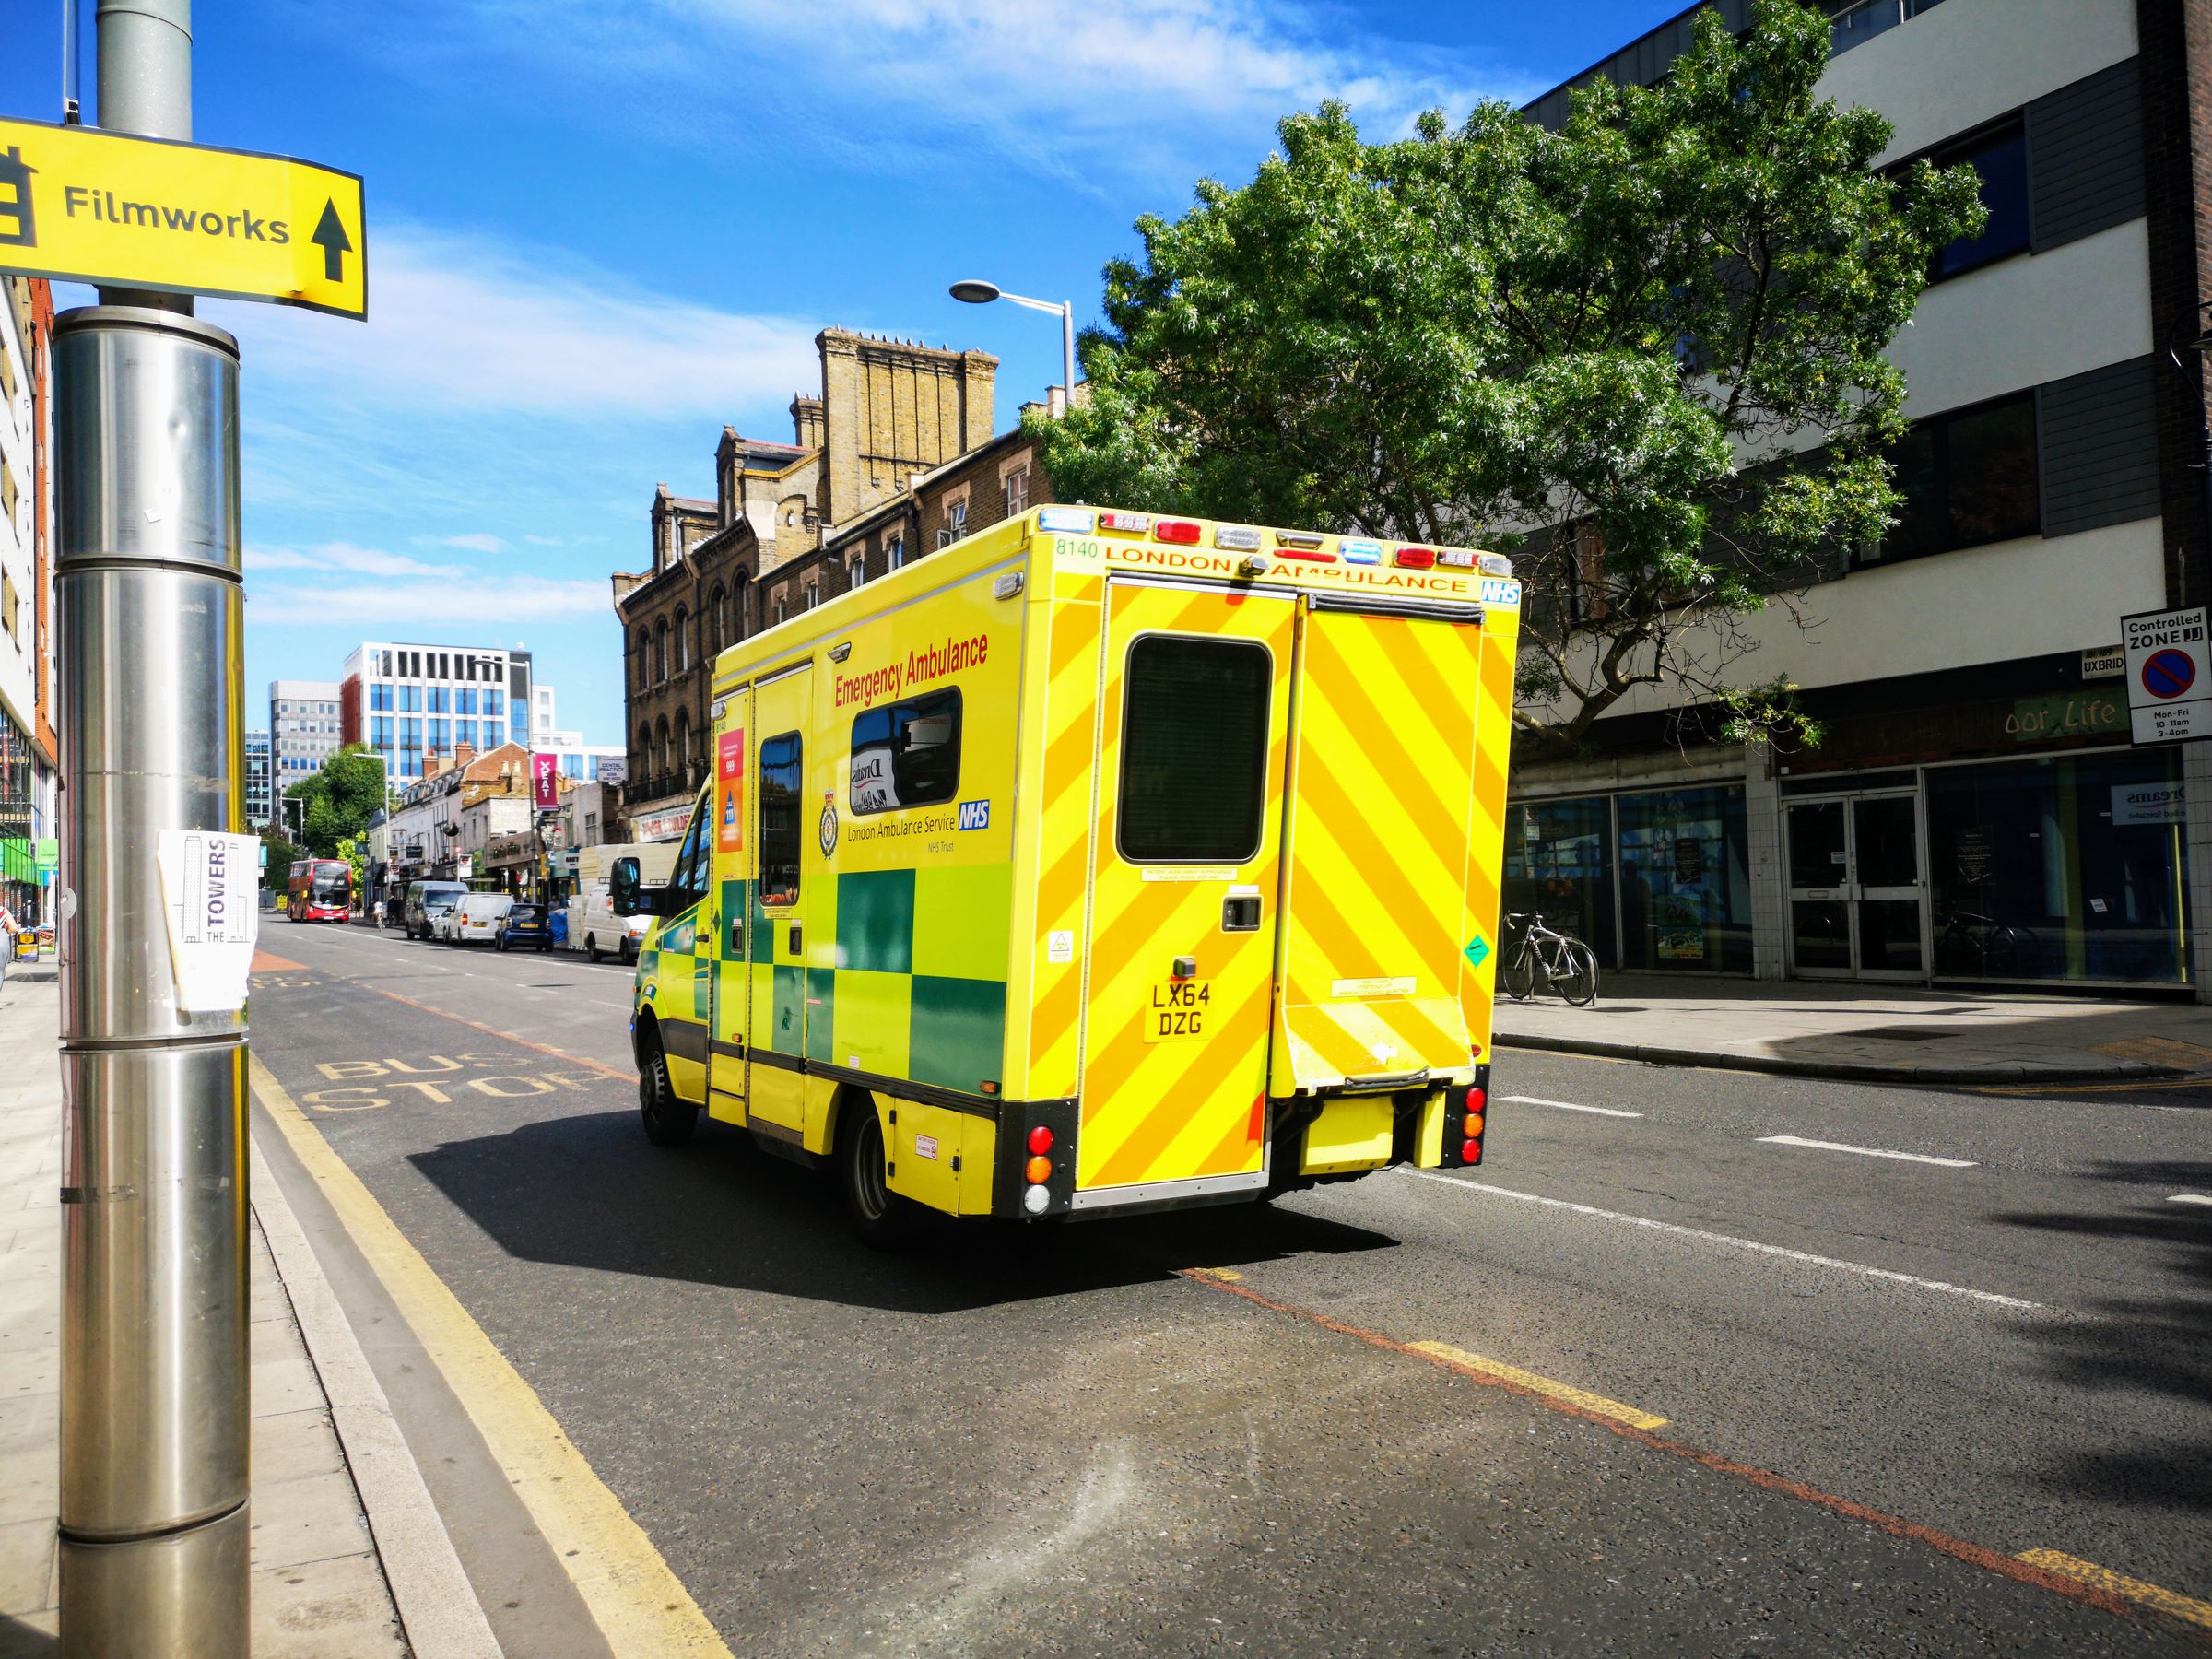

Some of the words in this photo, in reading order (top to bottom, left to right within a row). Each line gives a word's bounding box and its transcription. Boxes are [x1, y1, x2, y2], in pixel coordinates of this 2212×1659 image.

[65, 185, 290, 244] Filmworks
[1056, 538, 1099, 558] 8140
[1106, 546, 1230, 571] LONDON
[1482, 581, 1520, 605] NHS
[2129, 612, 2202, 633] Controlled
[2130, 630, 2181, 650] ZONE
[2184, 627, 2203, 642] JJ
[835, 662, 903, 708] Emergency
[906, 633, 988, 687] Ambulance
[2084, 657, 2124, 673] UXBRID
[2065, 700, 2116, 726] Life
[848, 824, 876, 841] London
[877, 816, 923, 838] Ambulance
[924, 814, 956, 833] Service
[959, 801, 989, 830] NHS
[928, 842, 939, 853] NHS
[941, 841, 955, 853] Trust
[207, 839, 226, 927] TOWERS
[207, 932, 224, 942] THE
[1153, 983, 1210, 1008] LX64
[1159, 1011, 1202, 1036] DZG
[315, 1053, 533, 1080] BUS
[300, 1070, 610, 1112] STOP
